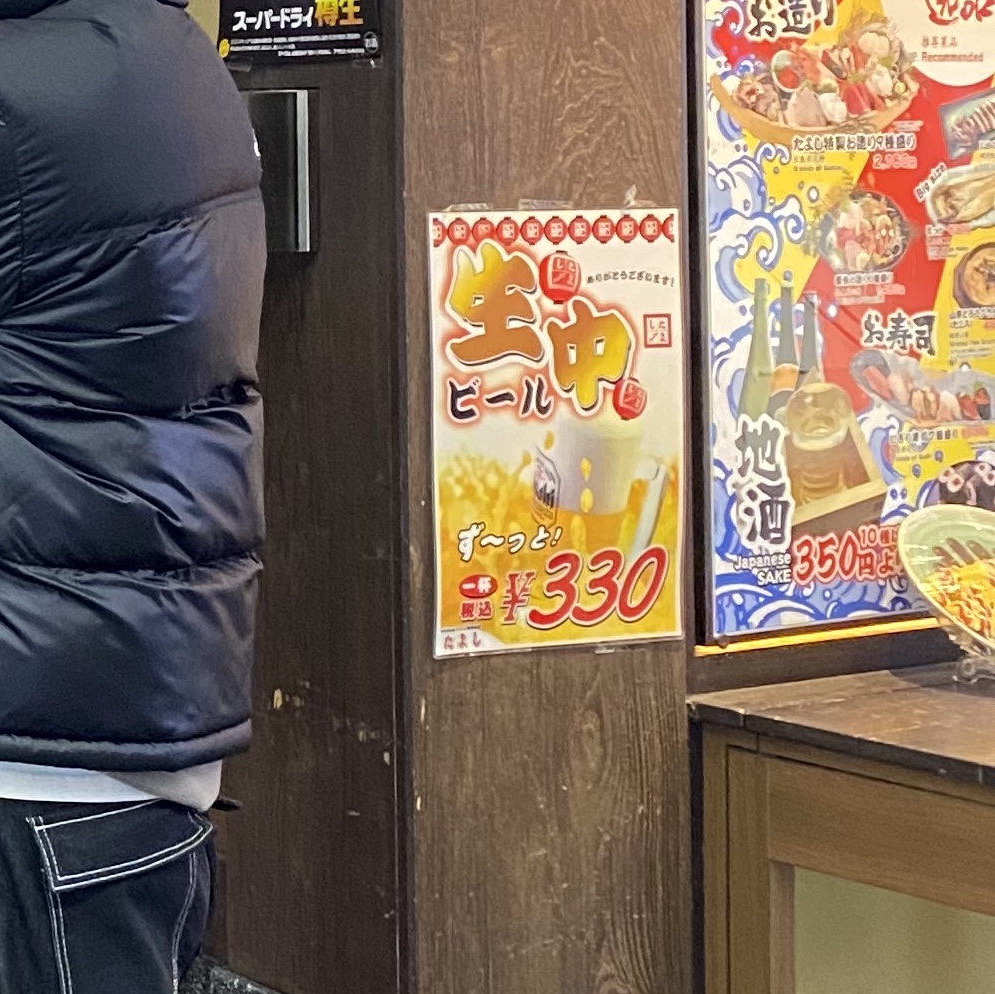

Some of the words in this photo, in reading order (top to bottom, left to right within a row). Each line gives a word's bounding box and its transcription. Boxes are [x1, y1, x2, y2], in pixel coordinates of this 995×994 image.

[864, 313, 936, 355] お寿司
[449, 377, 551, 420] ビール
[735, 420, 791, 545] 地酒
[735, 553, 791, 571] Japanese
[757, 570, 791, 586] SAKE
